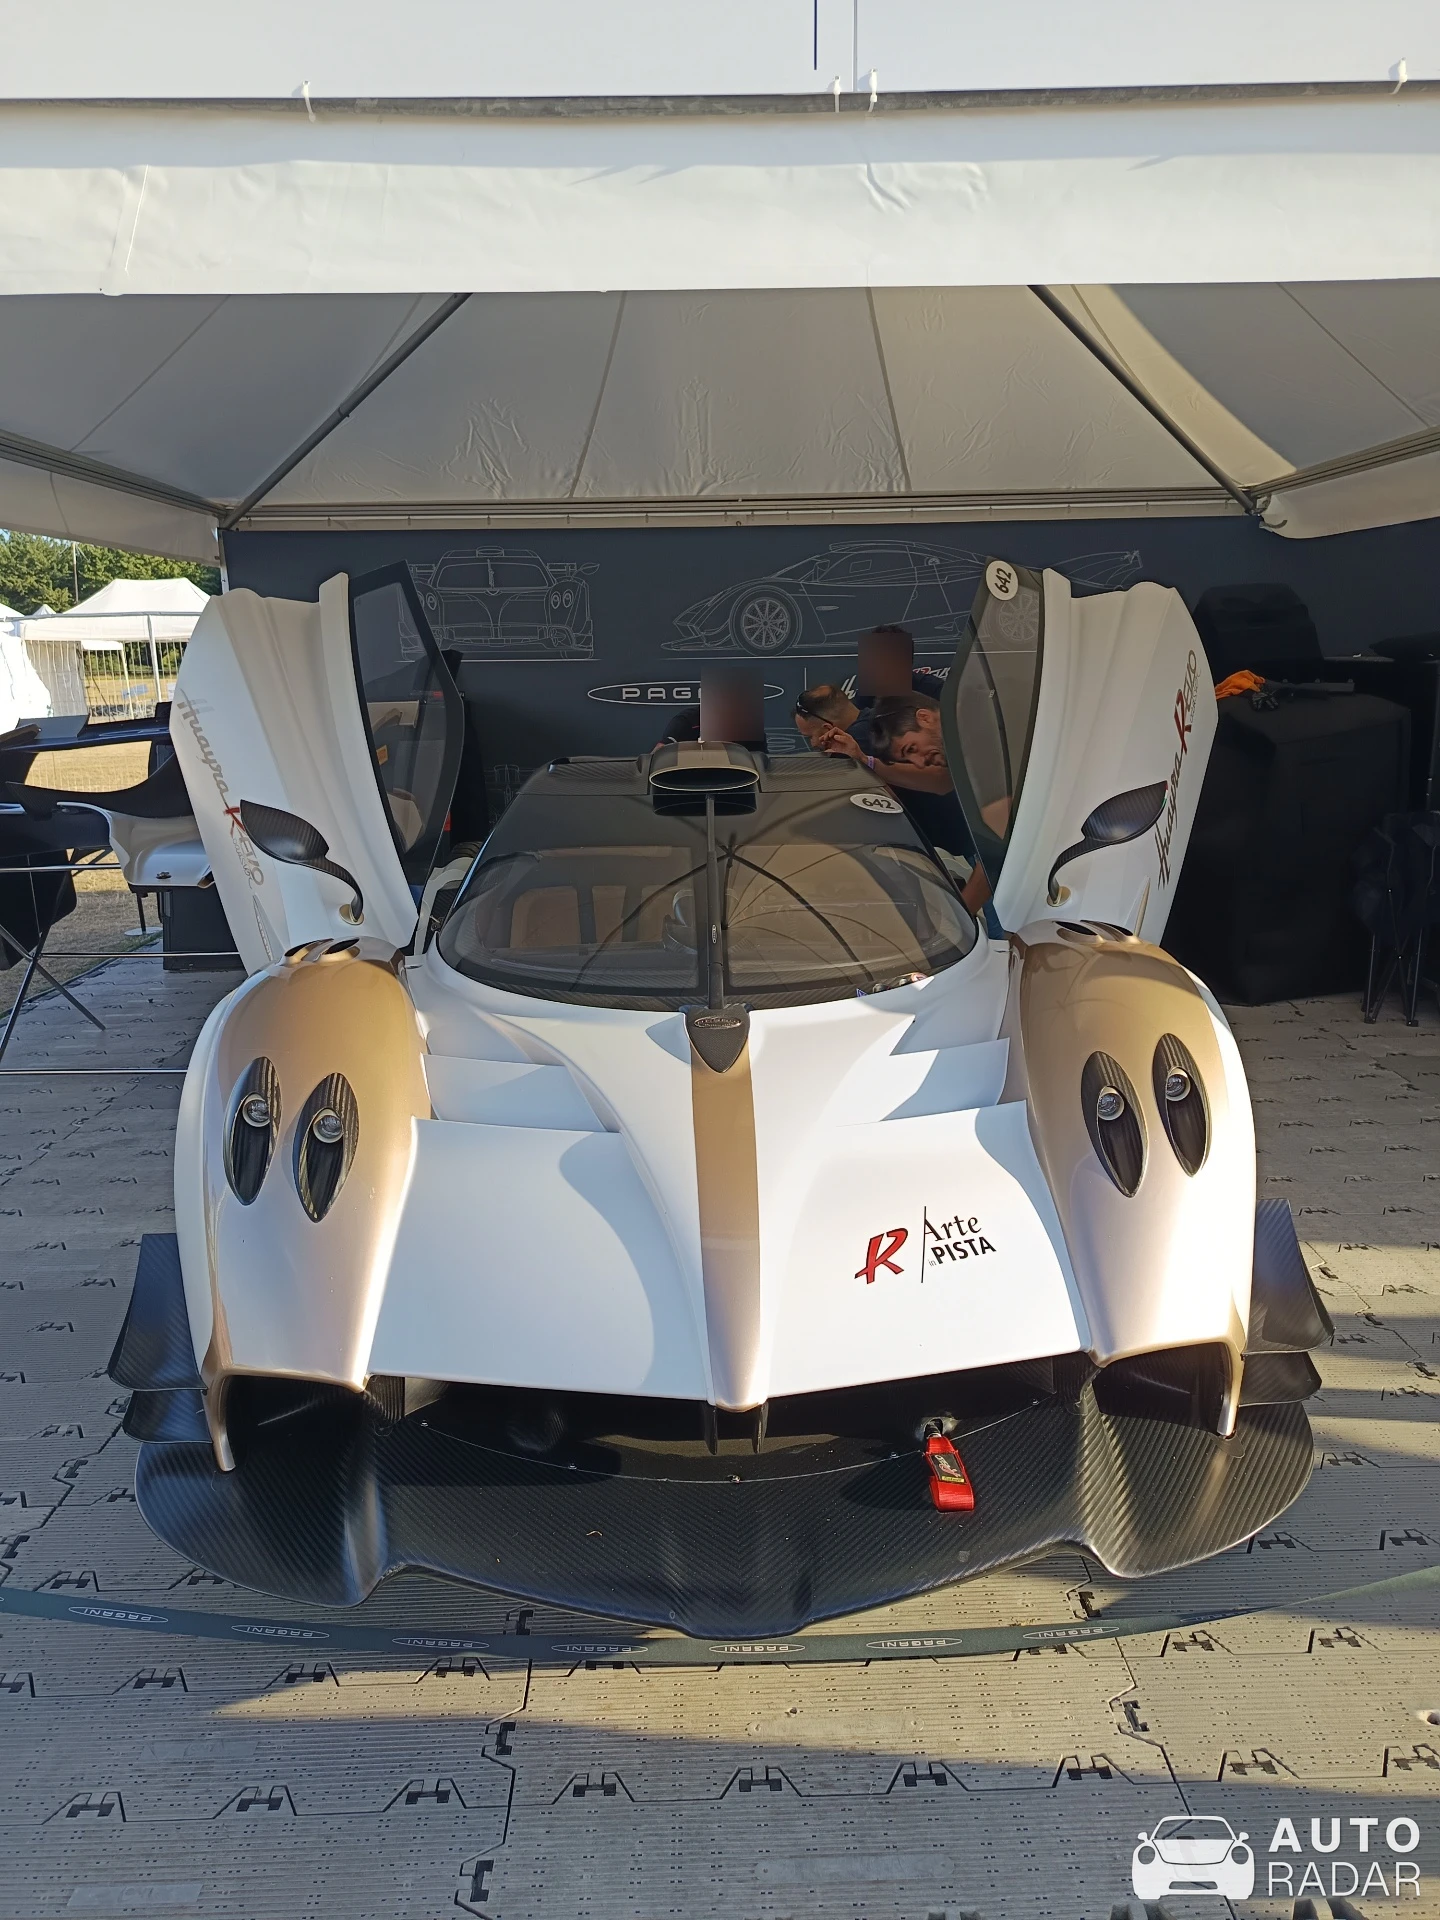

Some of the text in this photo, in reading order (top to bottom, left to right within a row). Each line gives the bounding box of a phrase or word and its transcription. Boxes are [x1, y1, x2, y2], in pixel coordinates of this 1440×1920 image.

[995, 567, 1012, 594] 642
[622, 687, 701, 700] PAG
[177, 689, 229, 802] Huayra
[862, 797, 896, 810] 642
[1155, 752, 1184, 890] Huayra
[924, 1215, 982, 1242] Arte
[854, 1227, 909, 1284] R
[931, 1237, 997, 1265] PISTA
[83, 1608, 152, 1622] PAGANI
[246, 1626, 313, 1637] PAGANI
[1037, 1627, 1104, 1639] PAGANI
[407, 1638, 473, 1648] PAGANI
[566, 1644, 632, 1653] PAGANI
[724, 1644, 789, 1653] PAGANI
[880, 1639, 947, 1648] PAGANI
